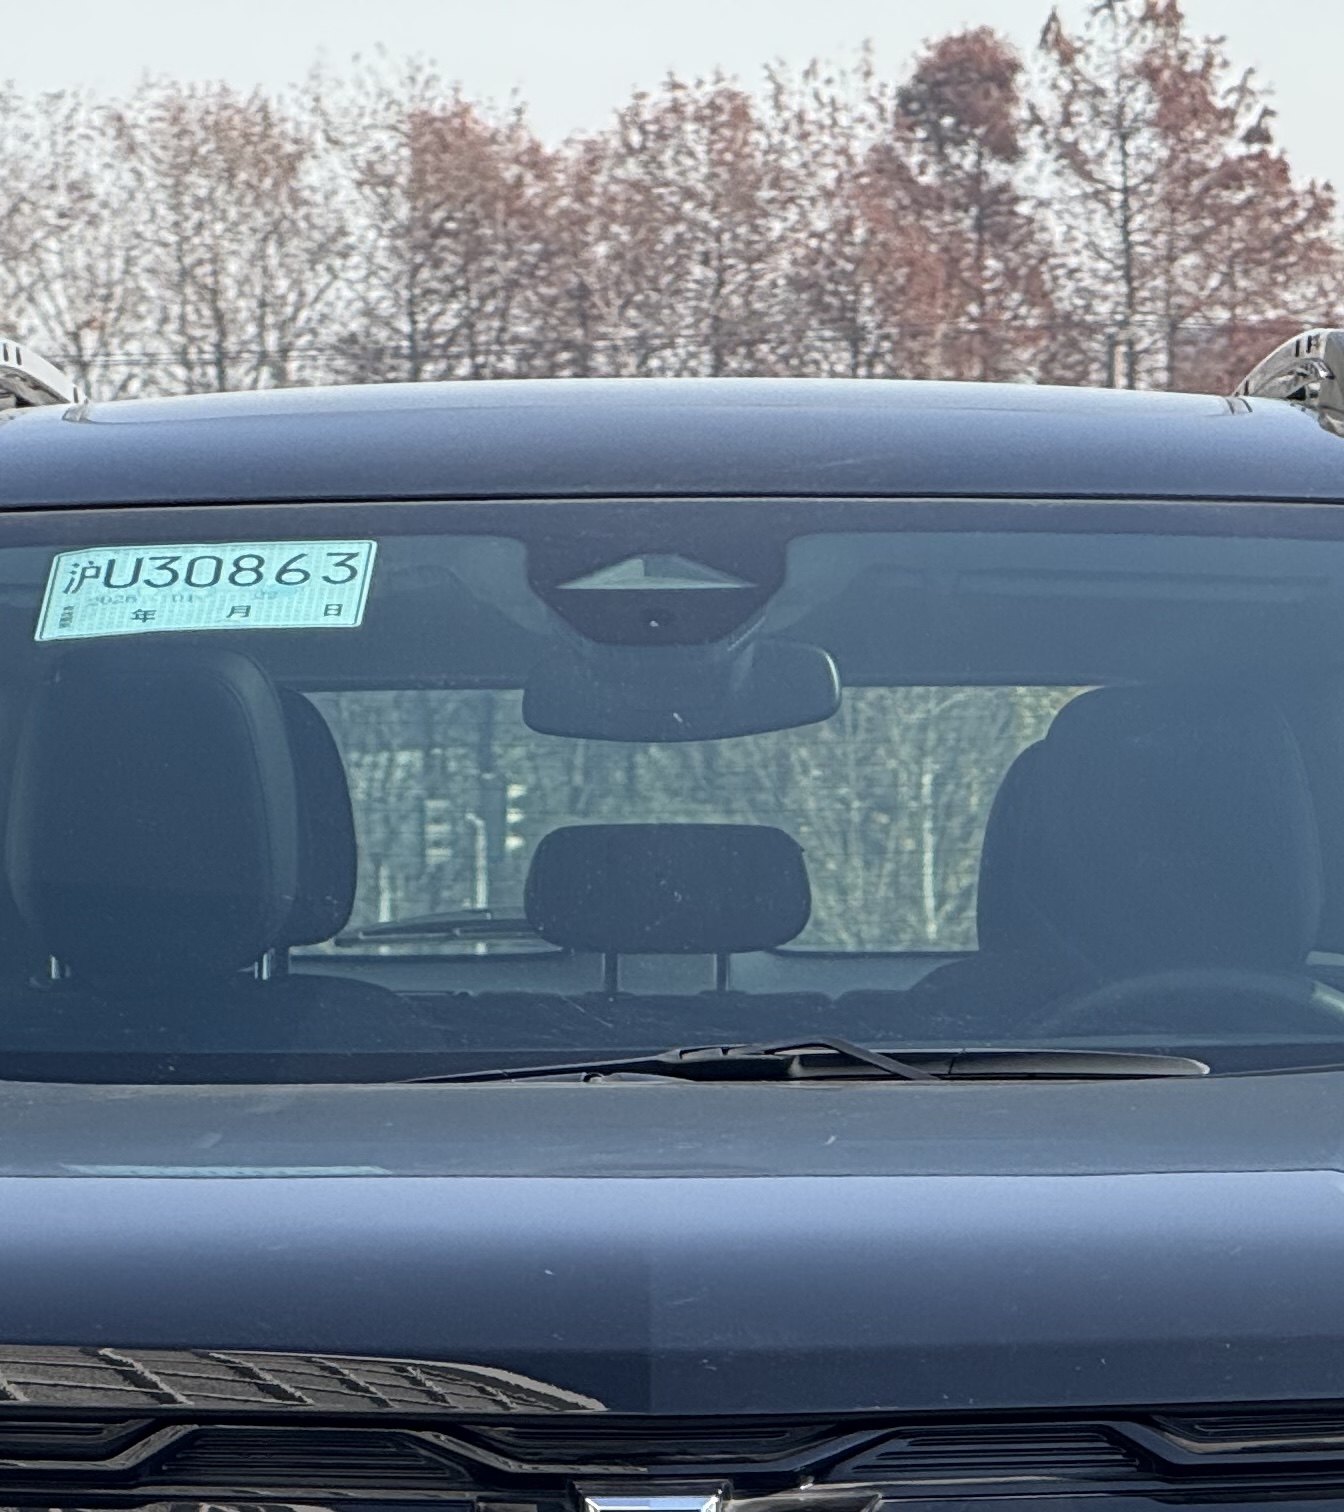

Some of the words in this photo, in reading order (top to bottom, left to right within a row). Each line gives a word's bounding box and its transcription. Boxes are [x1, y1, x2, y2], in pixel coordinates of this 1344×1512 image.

[62, 551, 360, 595] 沪U30863
[130, 608, 157, 623] 年
[225, 604, 252, 618] 月
[323, 603, 344, 617] 日
